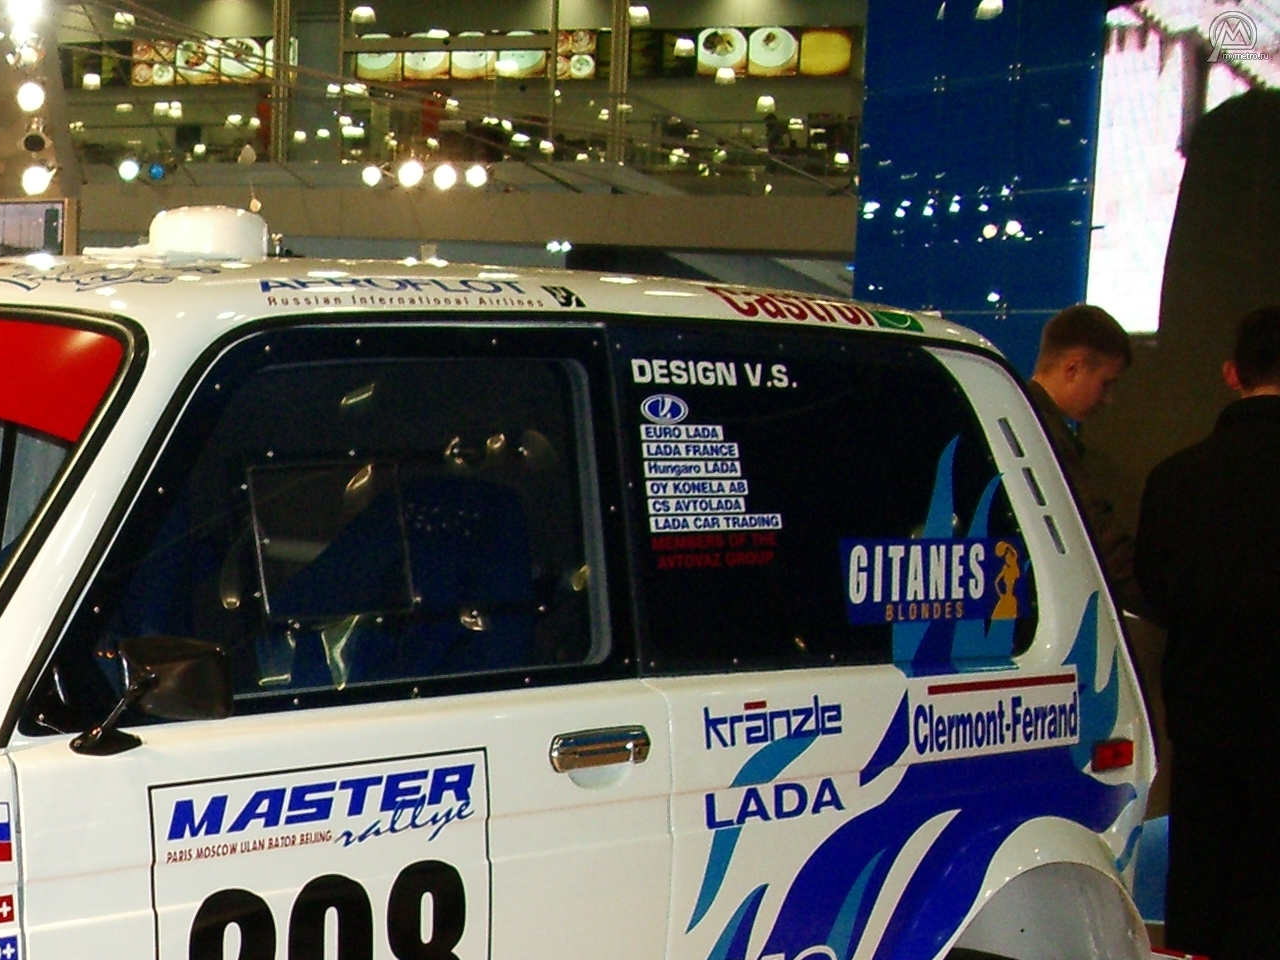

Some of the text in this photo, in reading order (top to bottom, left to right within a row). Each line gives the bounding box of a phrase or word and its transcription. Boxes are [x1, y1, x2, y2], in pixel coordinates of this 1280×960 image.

[261, 278, 526, 294] AEROFLOT
[267, 295, 544, 308] Russian International Airlines
[704, 286, 876, 328] Castrol
[631, 358, 798, 388] DESIGN V.S.
[644, 426, 720, 439] EURO LADA
[646, 444, 737, 456] LADA FRANCE
[648, 462, 739, 477] Hungaro LADA
[650, 481, 746, 494] OY KONELA AB
[652, 499, 742, 512] CS AVTOLADA
[654, 515, 780, 529] LADA CAR TRADING
[651, 532, 777, 551] MEMBERS OF THE
[657, 551, 775, 570] AVTOVAZ GROUP
[848, 543, 985, 604] GITANES
[885, 601, 964, 621] BLONDES
[913, 692, 1078, 755] Clermont-Ferrand
[167, 764, 476, 840] MASTER
[705, 777, 846, 830] LADA
[334, 793, 475, 848] rallye
[166, 830, 333, 864] PARIS MOSCOW ULAN BATOR BEIJING
